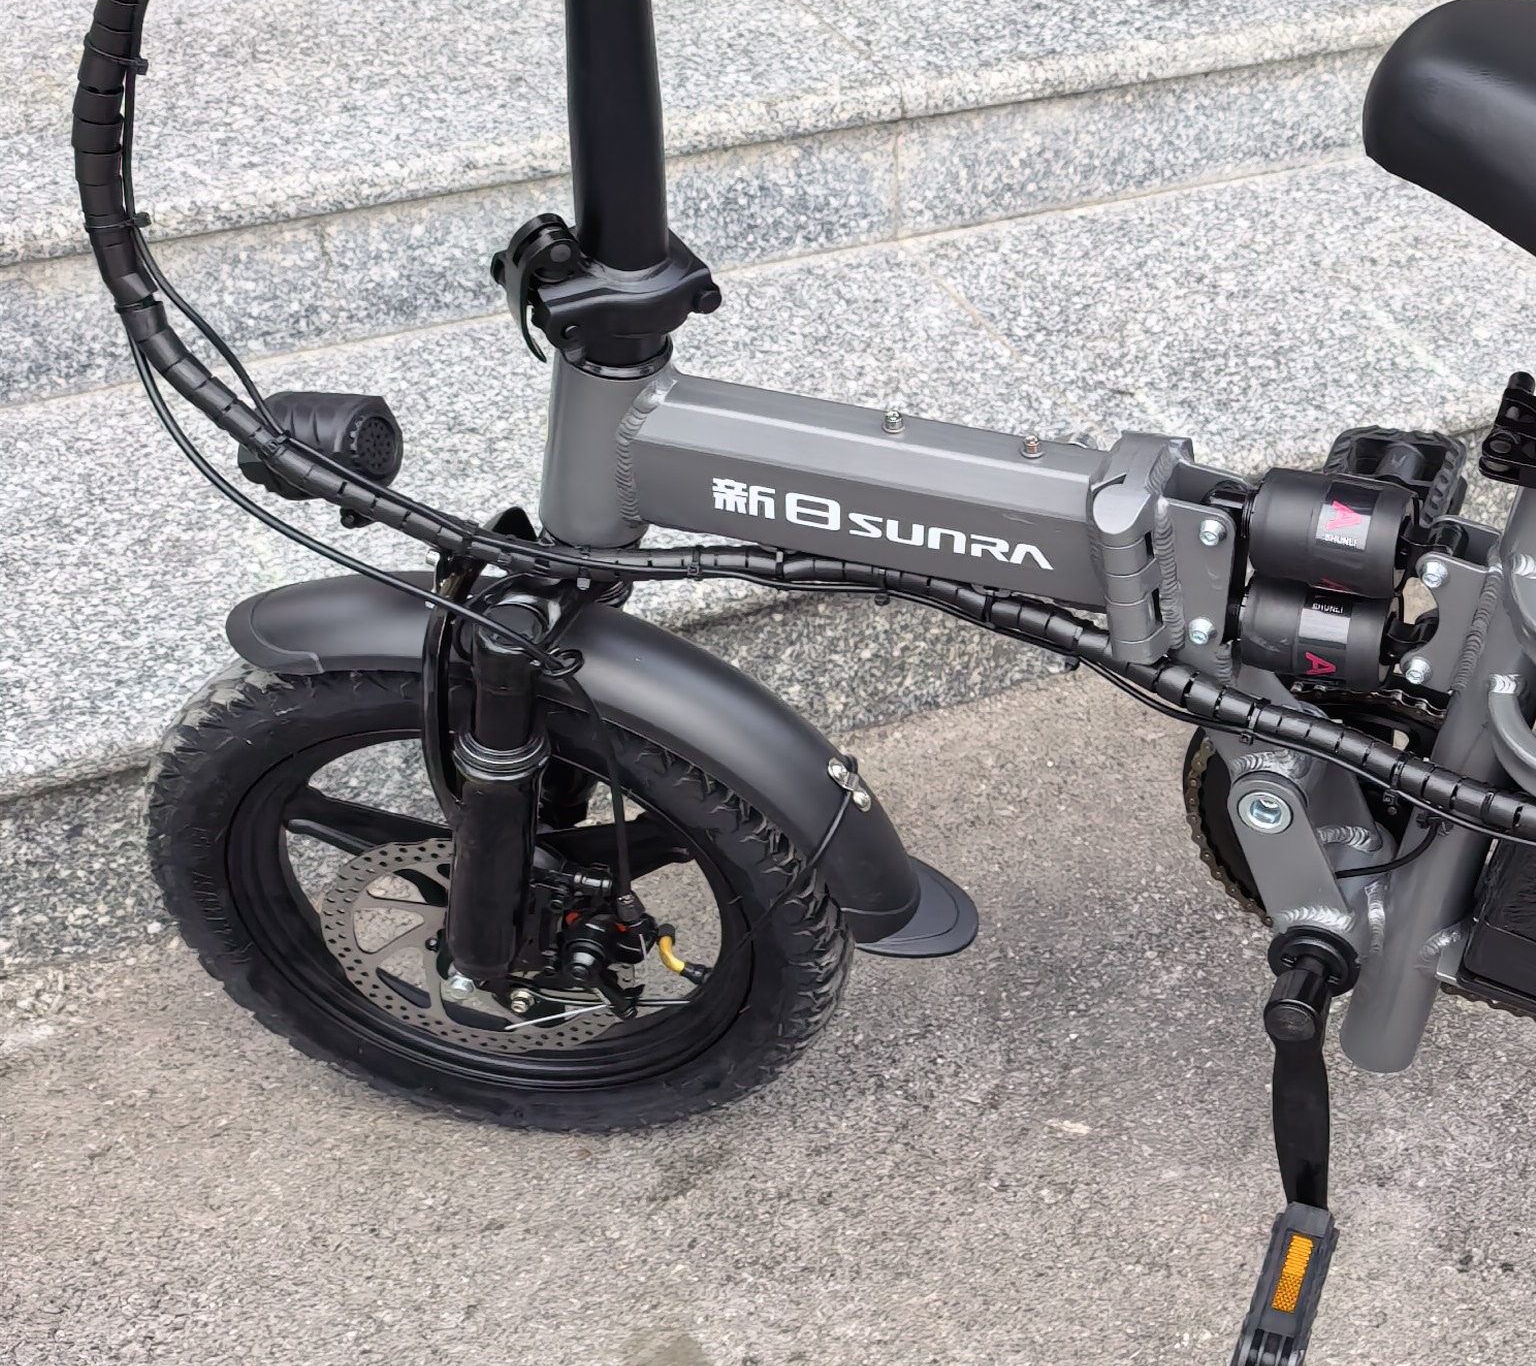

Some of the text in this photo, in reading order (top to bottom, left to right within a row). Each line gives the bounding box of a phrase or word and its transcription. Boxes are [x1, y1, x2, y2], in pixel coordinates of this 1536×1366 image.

[712, 477, 841, 531] 新日
[848, 512, 1054, 571] SUNRA
[1305, 651, 1337, 675] A
